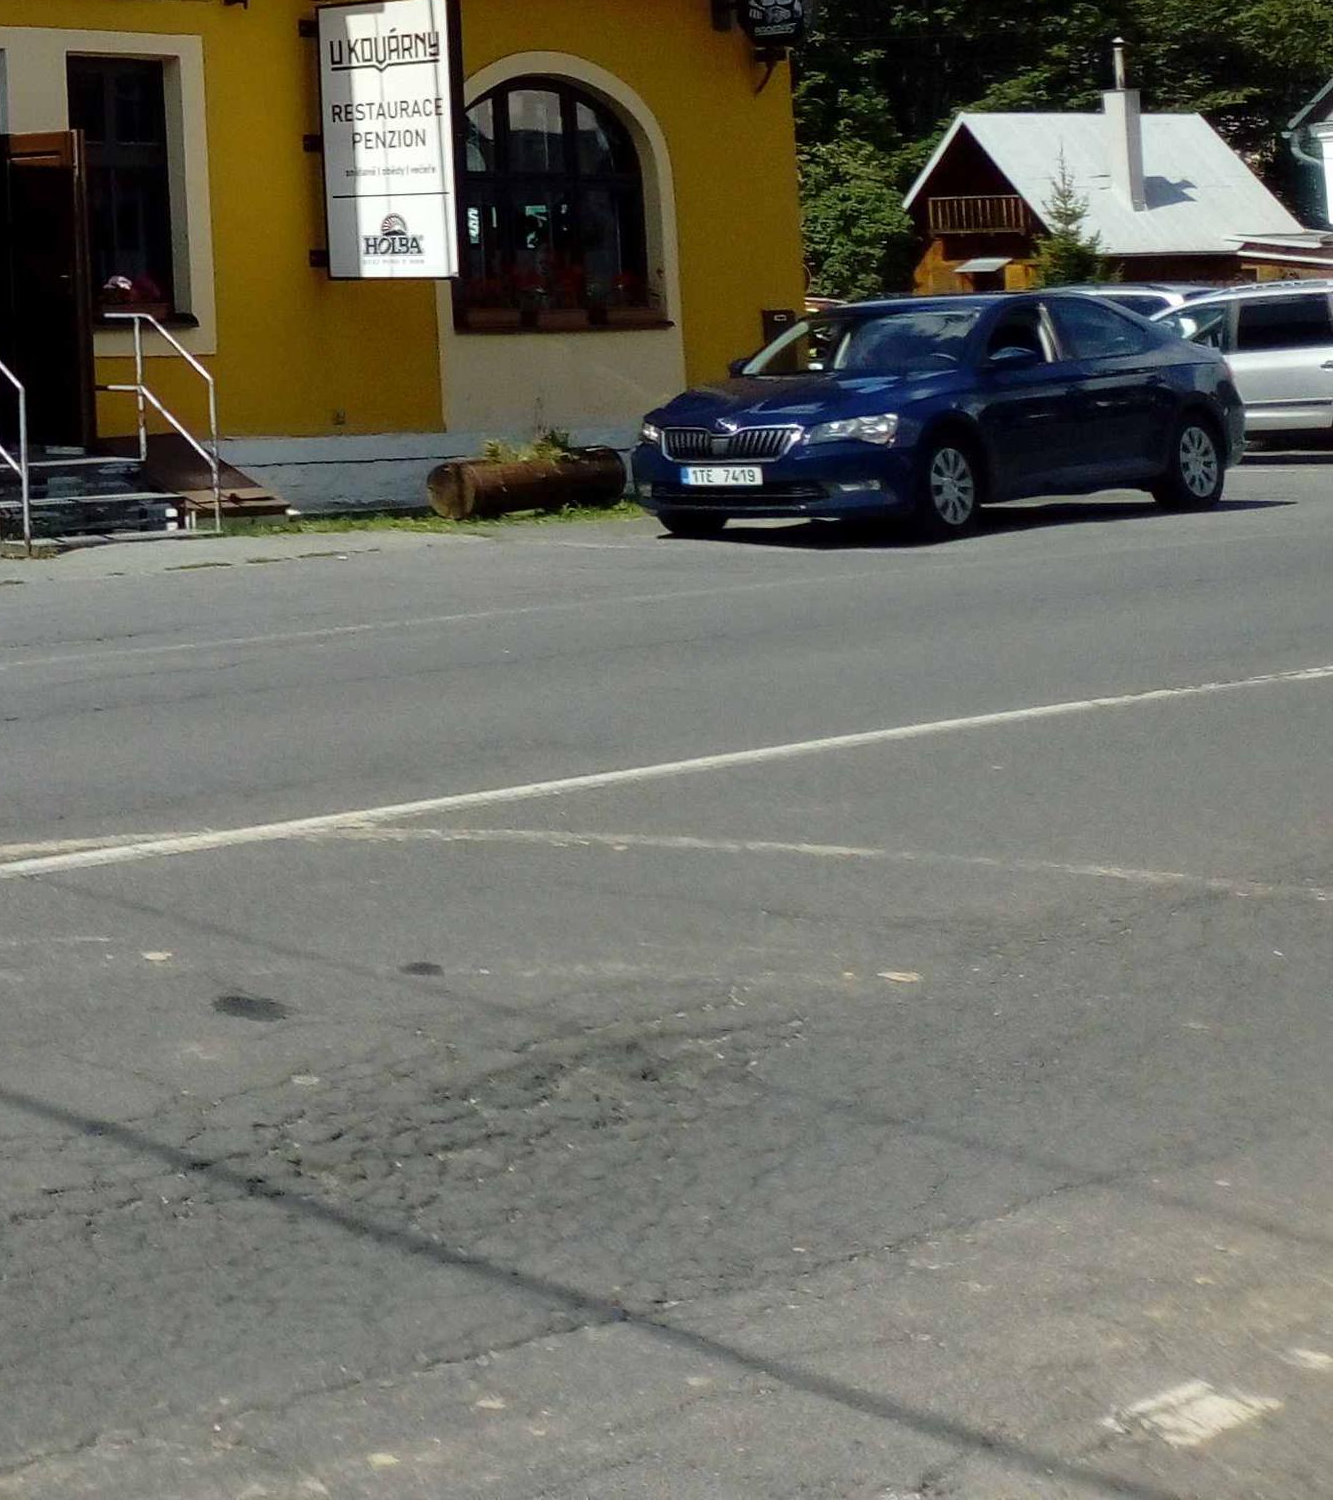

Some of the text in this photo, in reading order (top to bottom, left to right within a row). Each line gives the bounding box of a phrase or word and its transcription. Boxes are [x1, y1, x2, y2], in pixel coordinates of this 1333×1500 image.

[329, 27, 440, 65] U KOVÁRNY
[331, 97, 444, 123] RESTAURACE
[351, 128, 427, 151] PENZION
[363, 236, 423, 255] HOLBA
[722, 469, 756, 483] 7419
